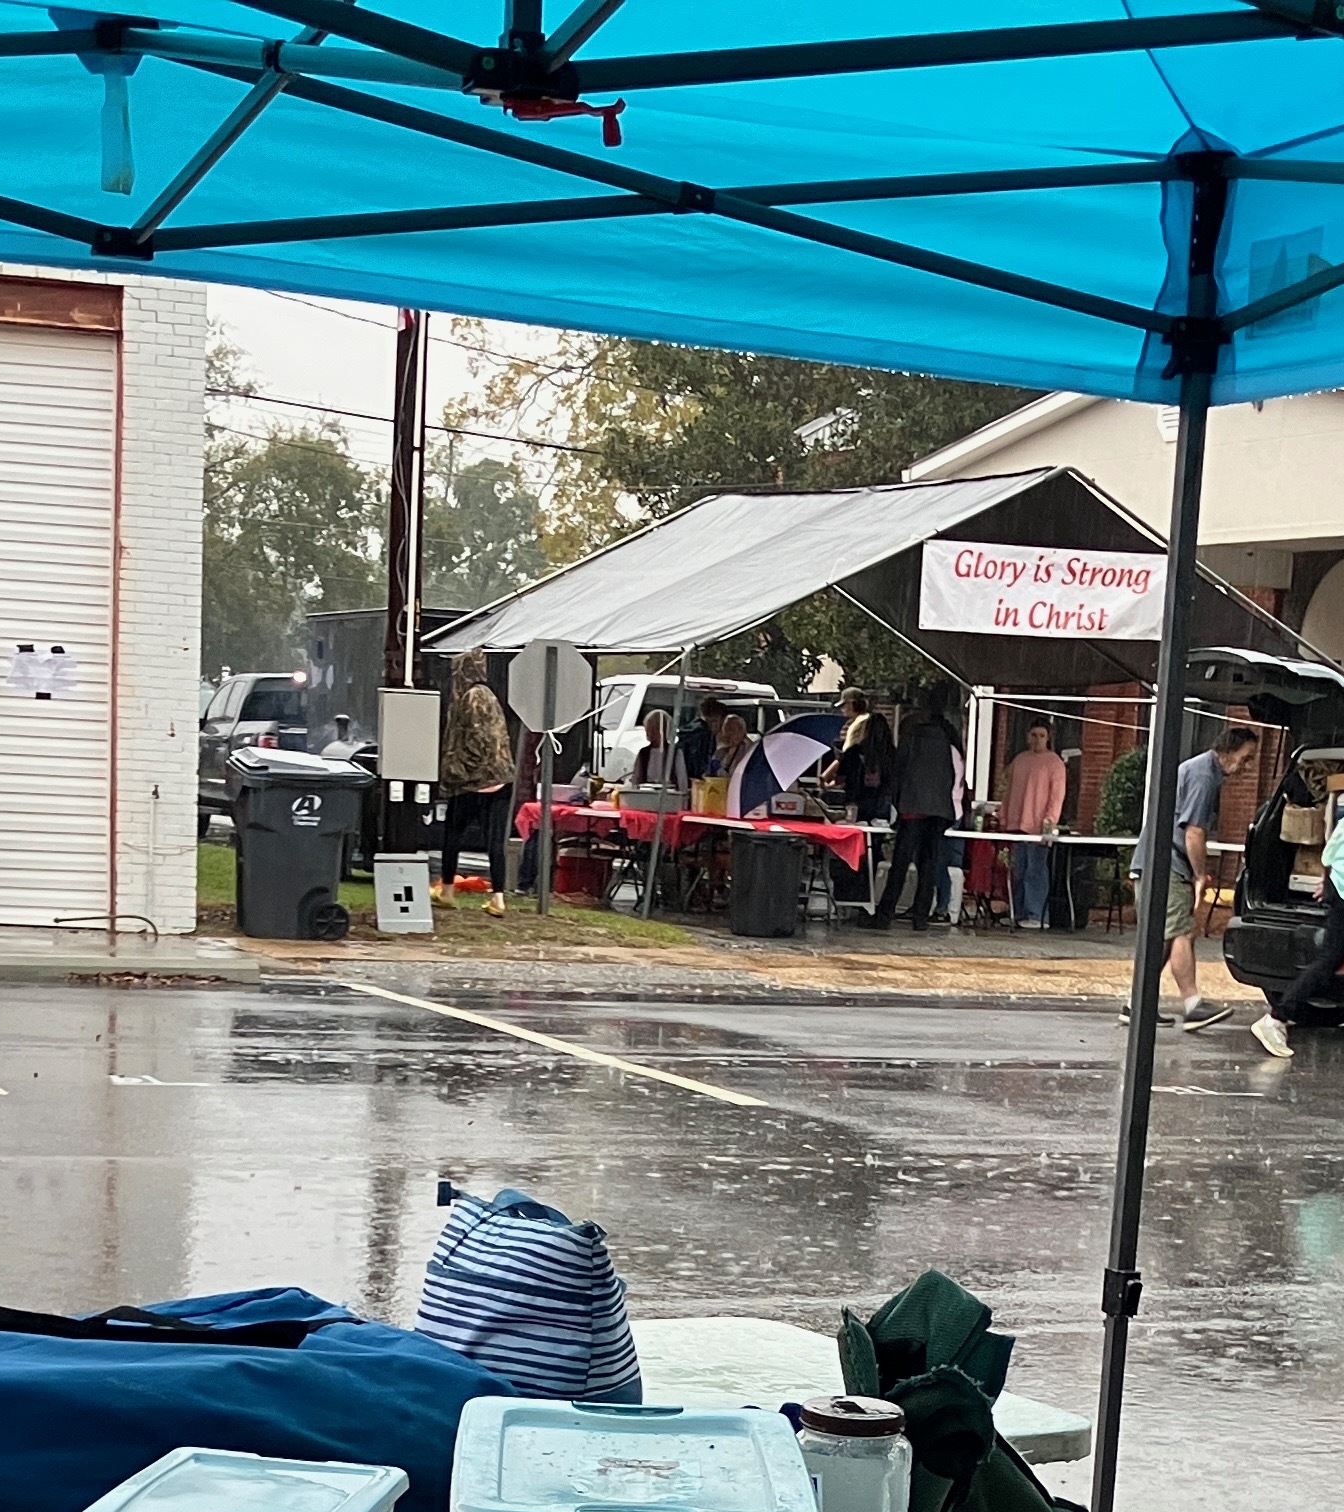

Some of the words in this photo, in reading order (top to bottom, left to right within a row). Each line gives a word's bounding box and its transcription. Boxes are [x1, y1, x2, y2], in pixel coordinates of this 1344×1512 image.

[954, 549, 1026, 588] Glory
[1033, 555, 1053, 584] is
[1061, 557, 1151, 594] Strong
[994, 598, 1019, 627] in
[1028, 601, 1109, 631] Christ
